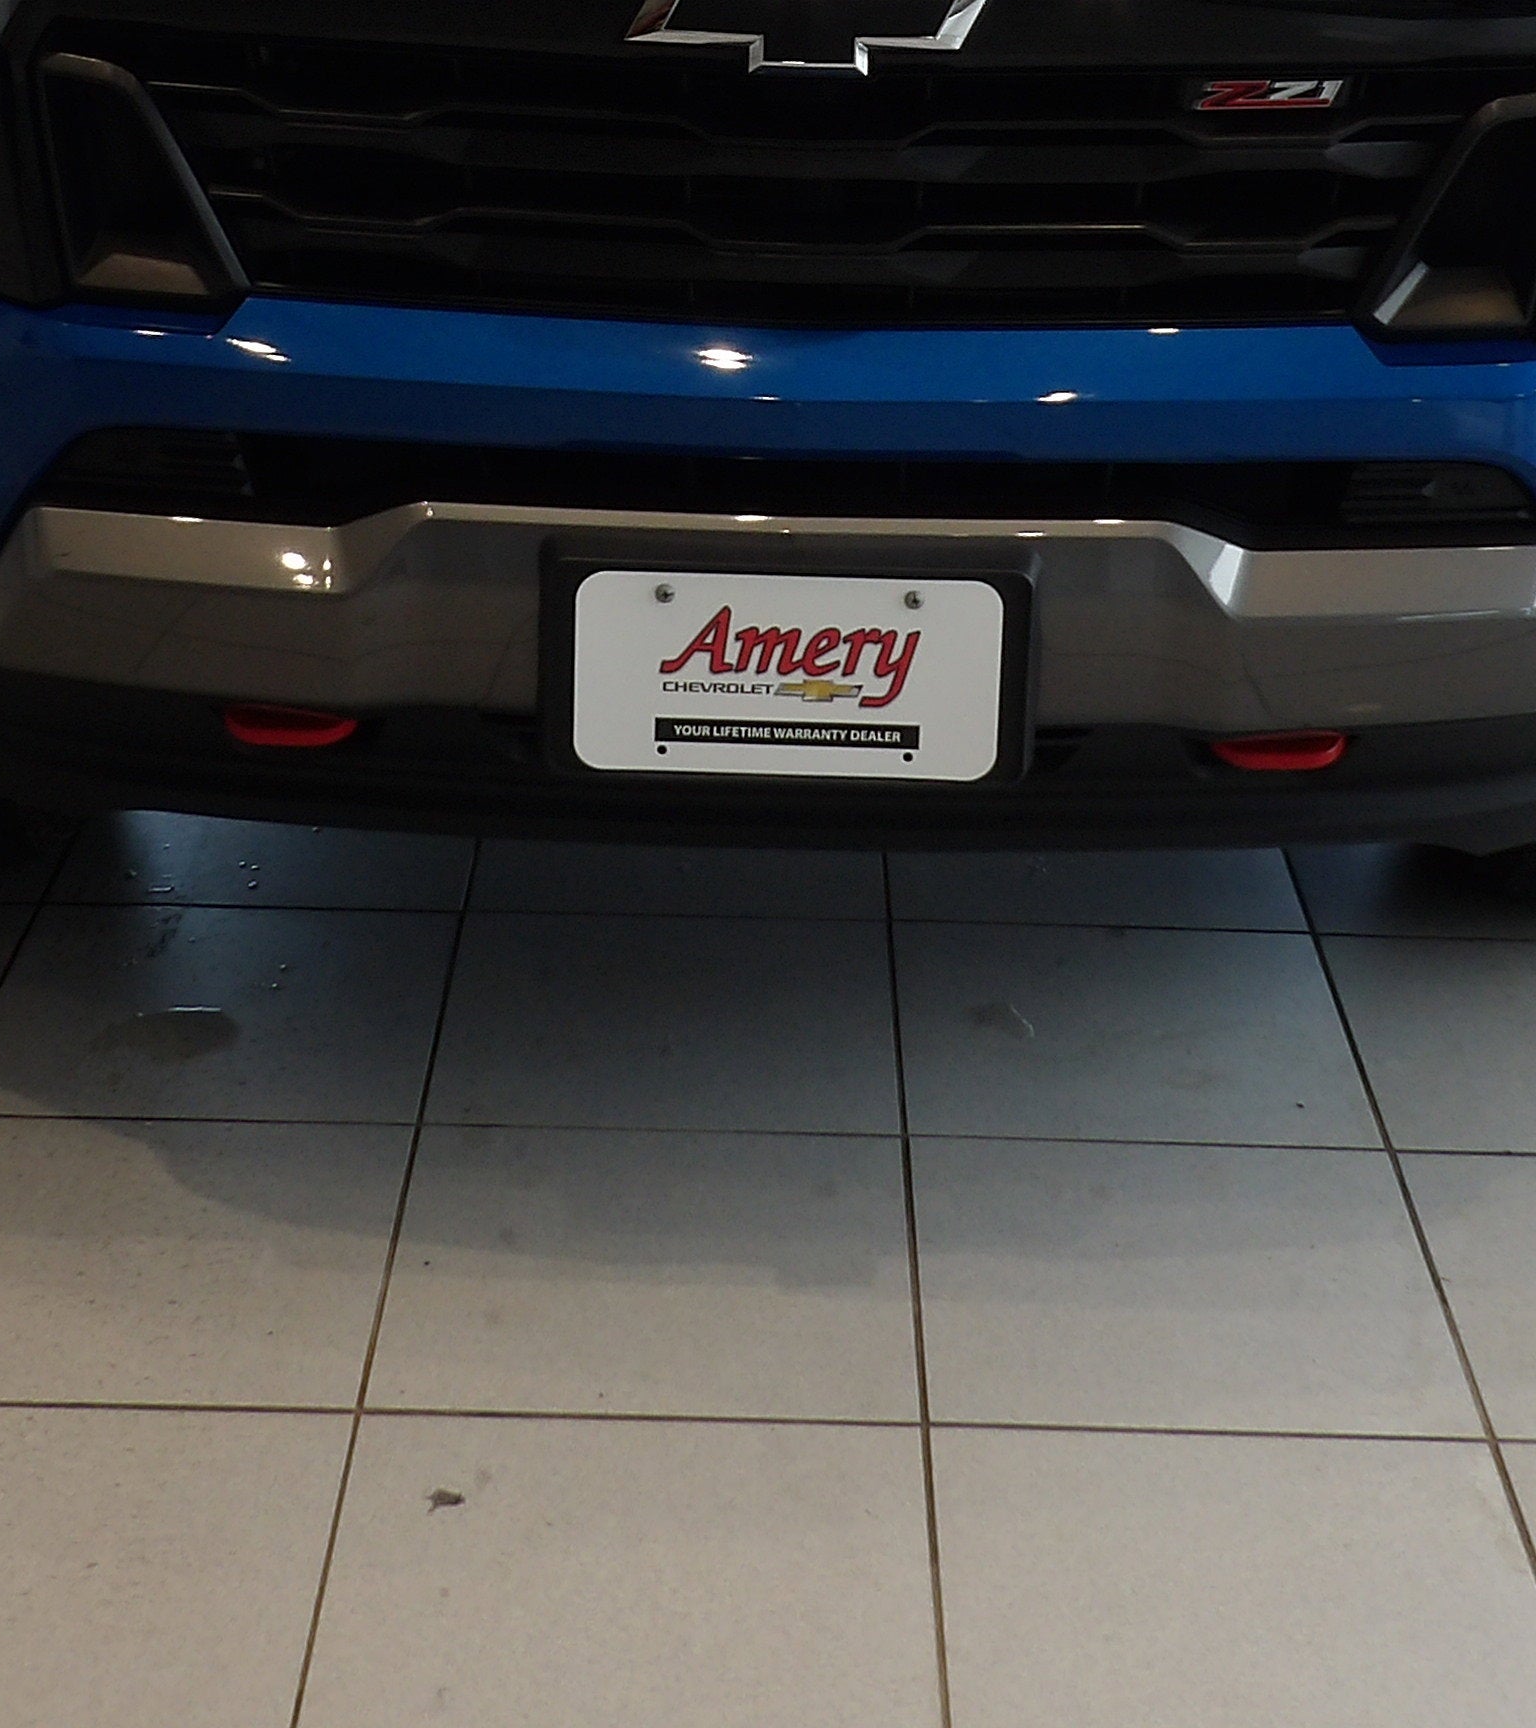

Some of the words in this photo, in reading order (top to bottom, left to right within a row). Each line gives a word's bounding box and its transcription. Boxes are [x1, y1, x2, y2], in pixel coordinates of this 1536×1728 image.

[1193, 79, 1343, 110] Z71
[659, 605, 921, 708] Amery
[662, 680, 774, 695] CHEVROLET
[674, 724, 711, 737] YOUR
[713, 725, 771, 740] LIFETIME
[773, 727, 848, 742] WARRANTY
[850, 729, 901, 743] DEALER
